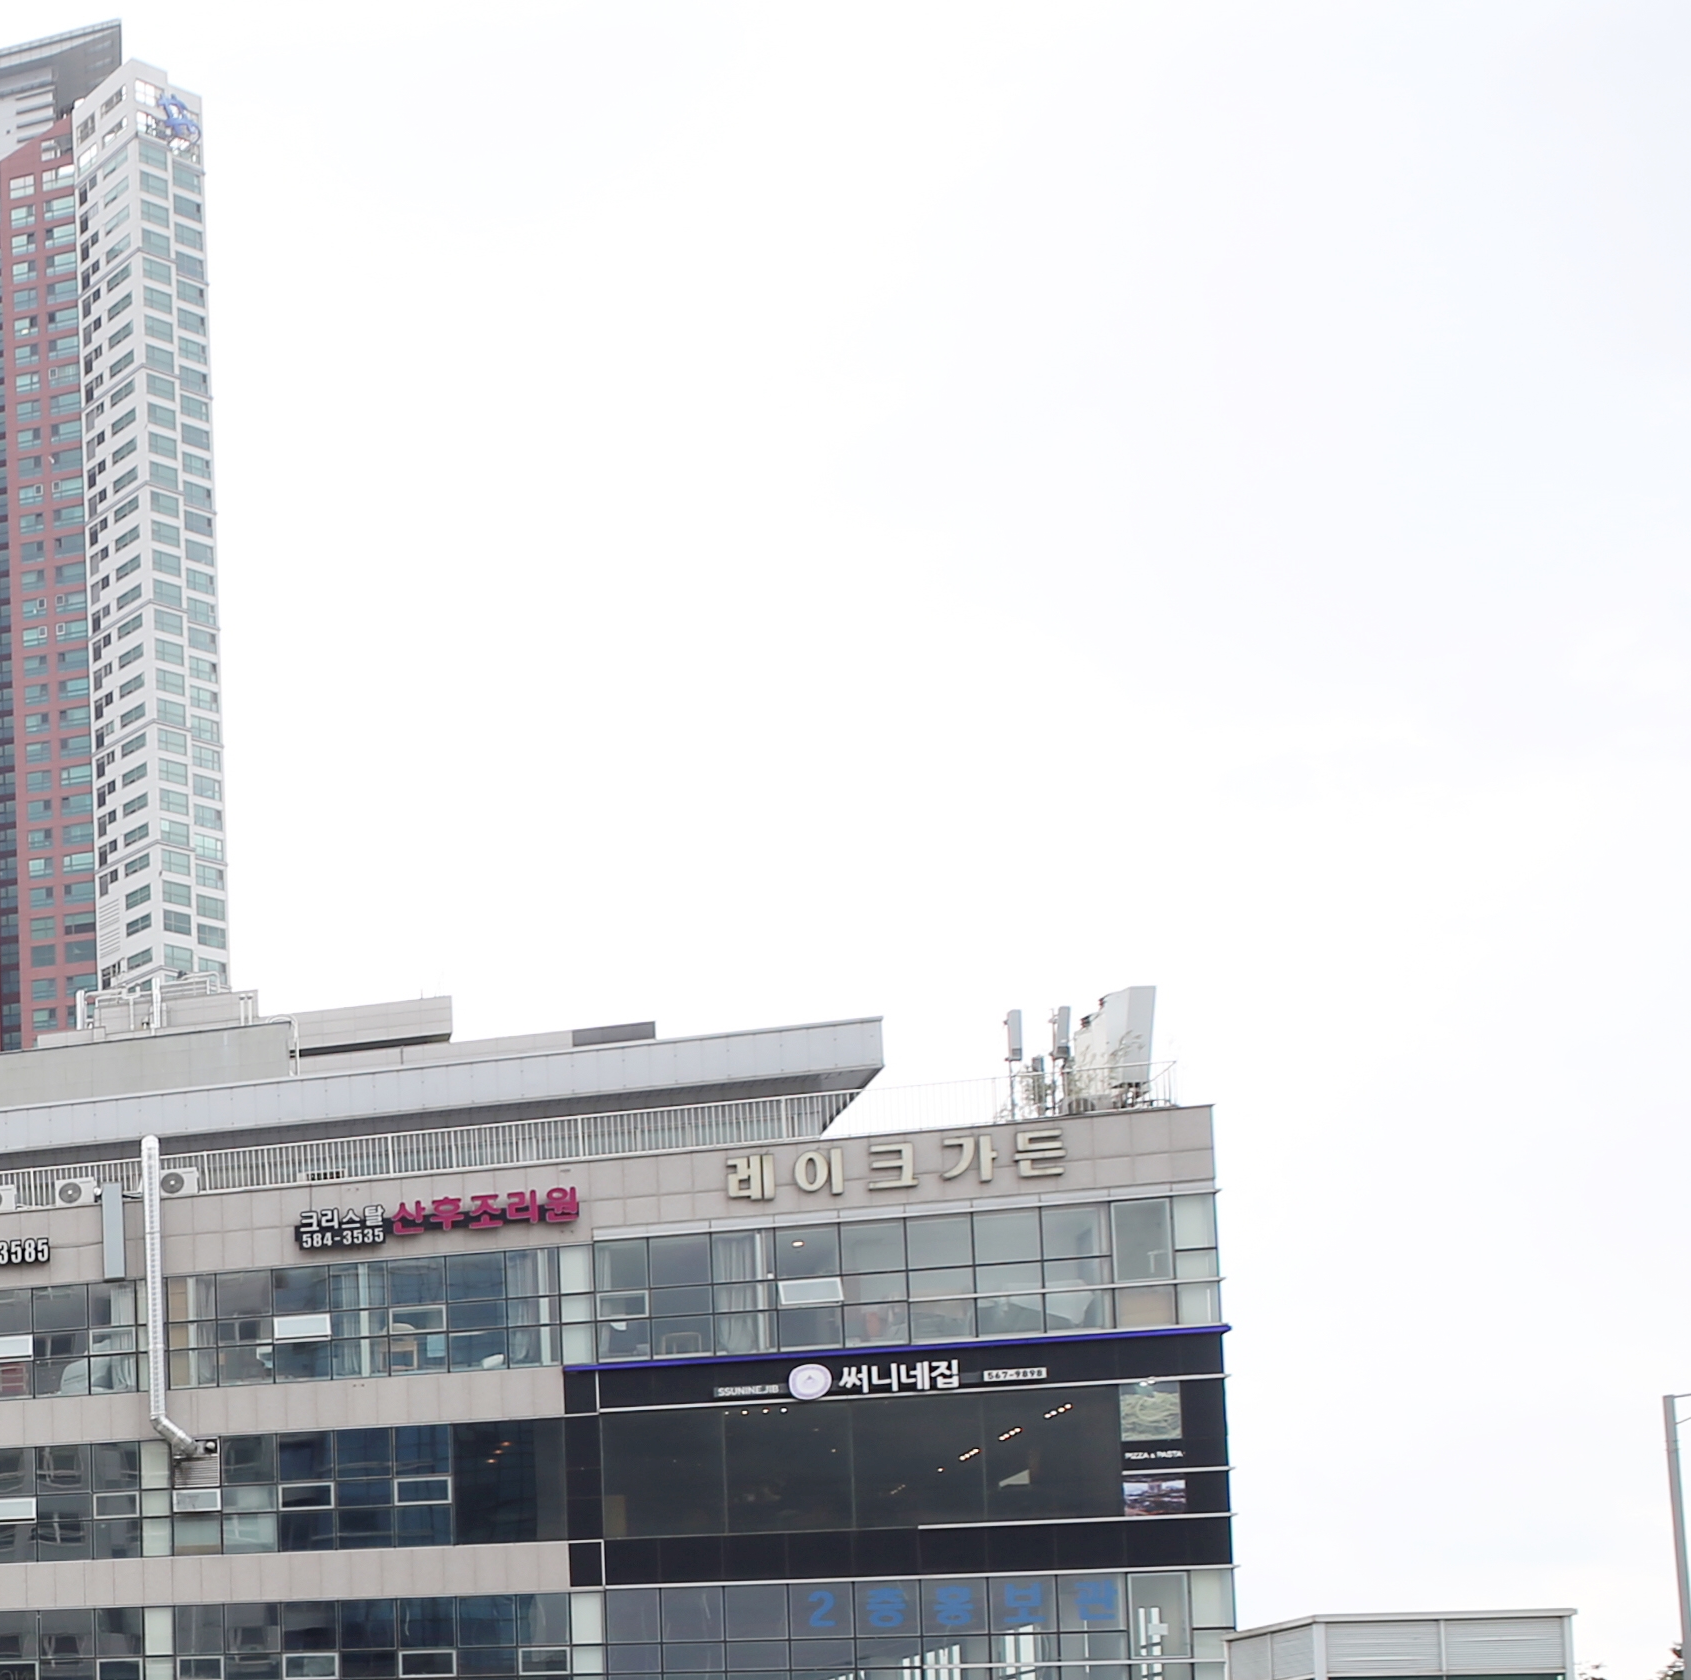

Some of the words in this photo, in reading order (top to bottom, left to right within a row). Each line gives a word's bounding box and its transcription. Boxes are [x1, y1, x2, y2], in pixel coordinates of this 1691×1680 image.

[726, 1129, 1066, 1201] 레이크가든
[299, 1204, 386, 1233] 크리스탈
[391, 1187, 579, 1235] 산후조리원
[302, 1228, 385, 1249] 584-3535
[838, 1358, 960, 1394] 써니네집
[987, 1369, 1043, 1380] 567-9898
